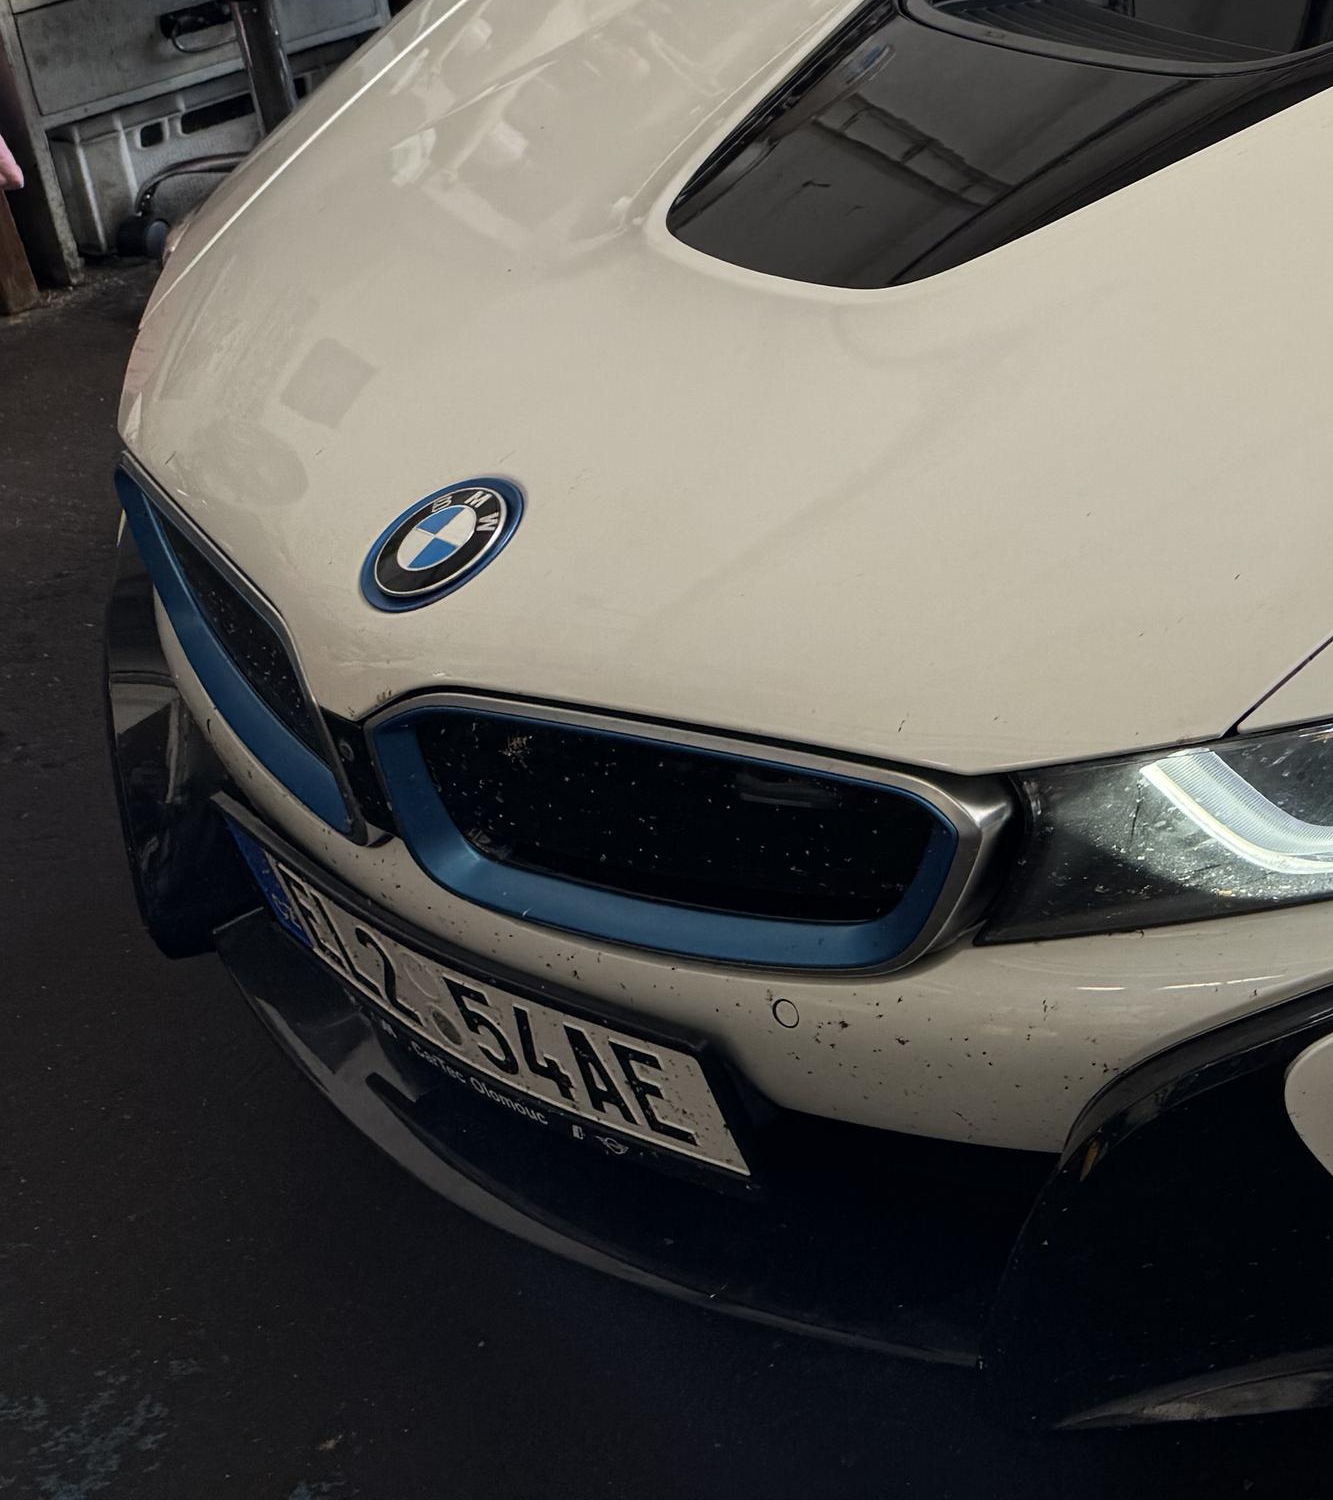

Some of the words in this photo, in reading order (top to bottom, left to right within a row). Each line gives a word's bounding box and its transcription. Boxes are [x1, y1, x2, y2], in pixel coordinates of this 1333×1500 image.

[431, 489, 500, 532] BMW
[410, 1040, 468, 1086] CarTec
[471, 1075, 549, 1126] Olomouc
[441, 975, 699, 1148] 54AE
